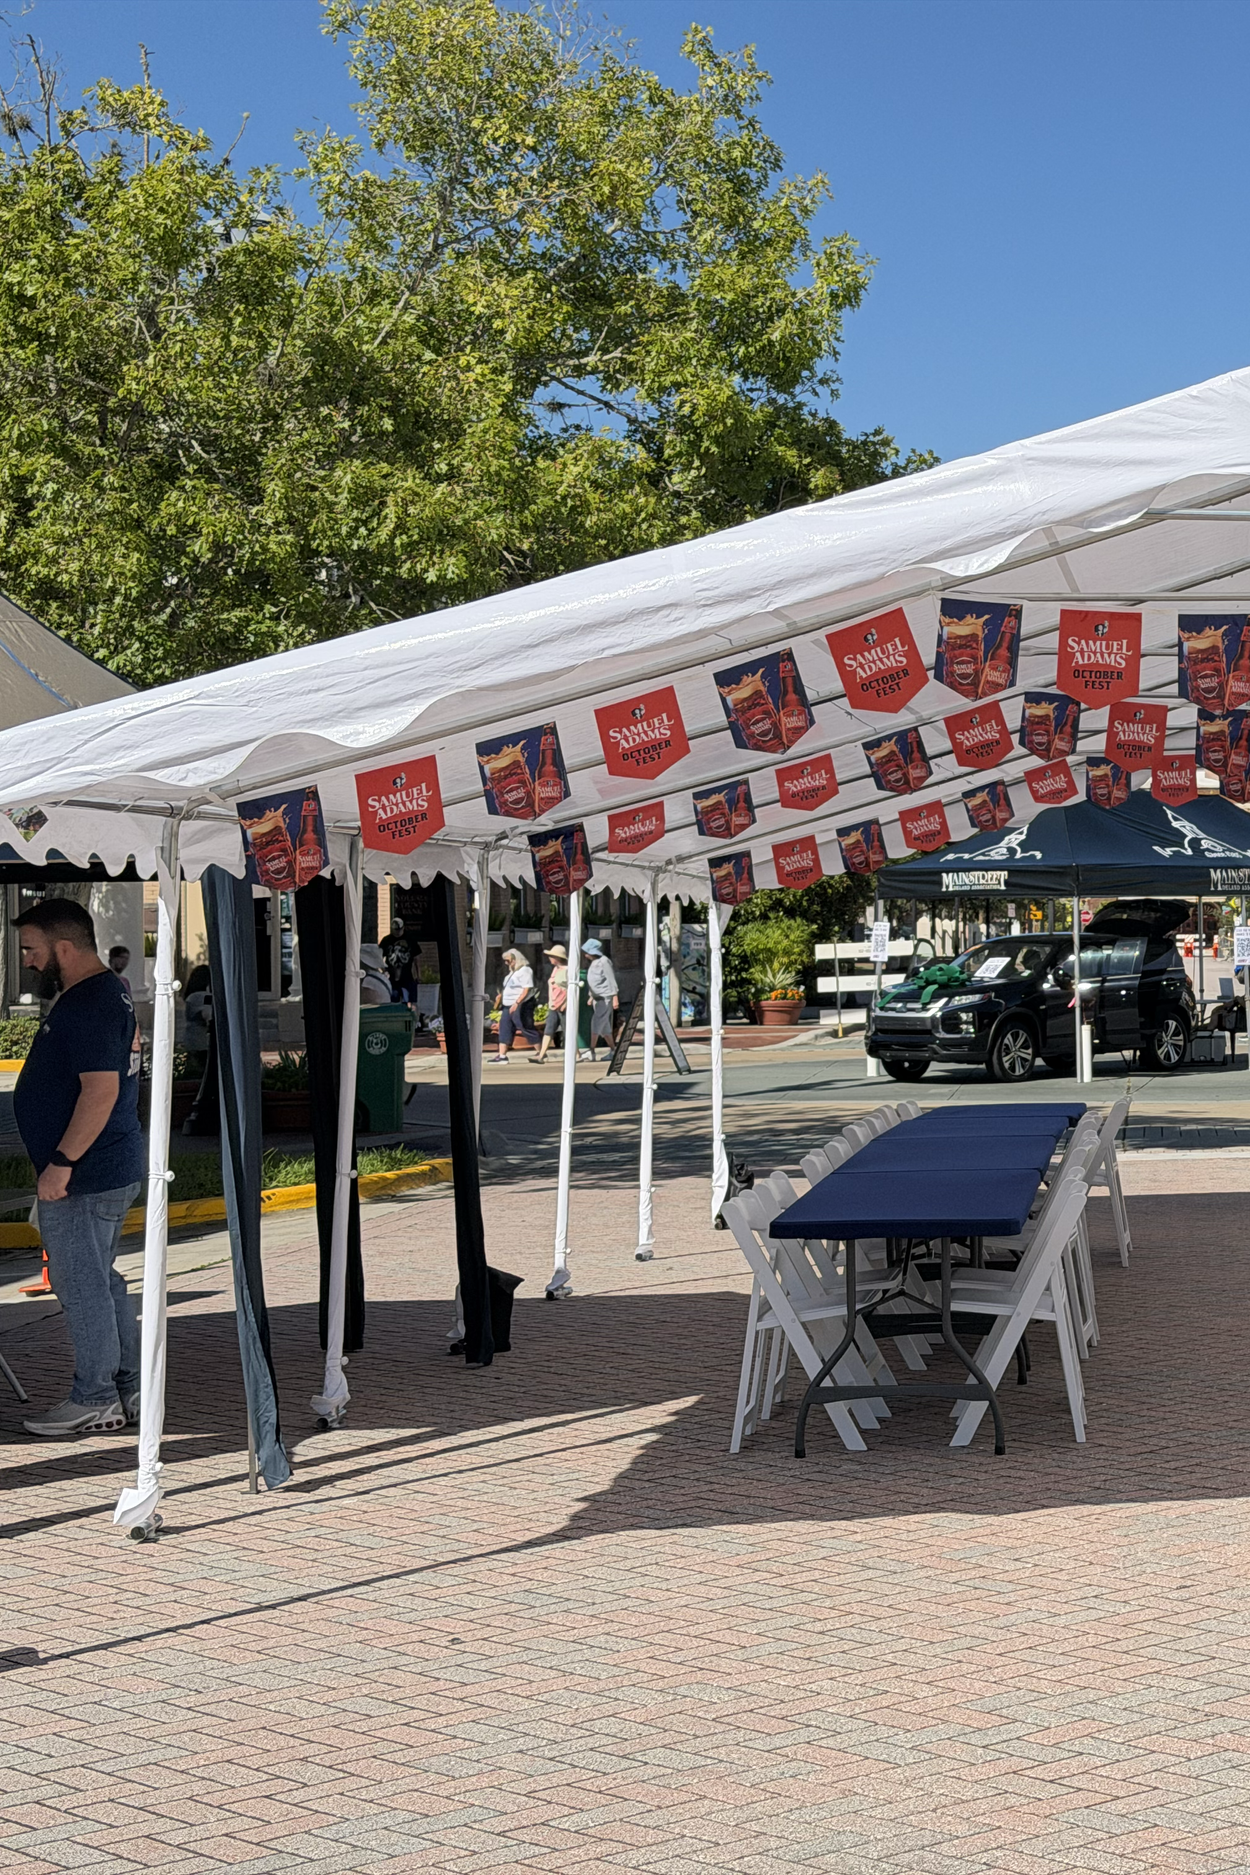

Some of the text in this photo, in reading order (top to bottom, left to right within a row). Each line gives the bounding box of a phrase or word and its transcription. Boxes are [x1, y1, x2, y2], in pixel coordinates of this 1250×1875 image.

[844, 637, 908, 670] SAMUEL
[1067, 637, 1132, 655] SAMUEL
[856, 653, 907, 682] ADAMS
[1071, 652, 1126, 668] ADAMS
[861, 669, 910, 692] OCTOBER
[1073, 669, 1123, 681] OCTOBER
[876, 683, 902, 699] FEST
[1084, 681, 1111, 690] FEST
[609, 713, 674, 742] SAMUEL
[955, 720, 1001, 742] SAMUEL
[1113, 720, 1160, 736] SAMUEL
[618, 726, 671, 752] ADAMS
[963, 730, 1000, 749] ADAMS
[1116, 732, 1155, 744] ADAMS
[622, 740, 672, 762] OCTOBER
[635, 752, 662, 767] FEST
[784, 769, 830, 789] SAMUEL
[1032, 773, 1068, 790] SAMUEL
[1157, 769, 1193, 780] SAMUEL
[1160, 778, 1190, 787] ADAMS
[789, 779, 827, 793] ADAMS
[1037, 782, 1067, 795] ADAMS
[368, 783, 432, 811] SAMUEL
[375, 797, 428, 823] ADAMS
[378, 812, 428, 833] OCTOBER
[906, 814, 942, 831] SAMUEL
[911, 823, 941, 836] ADAMS
[391, 825, 417, 840] FEST
[779, 851, 815, 867] SAMUEL
[784, 860, 814, 873] ADAMS
[941, 870, 1008, 891] MAINSTREET
